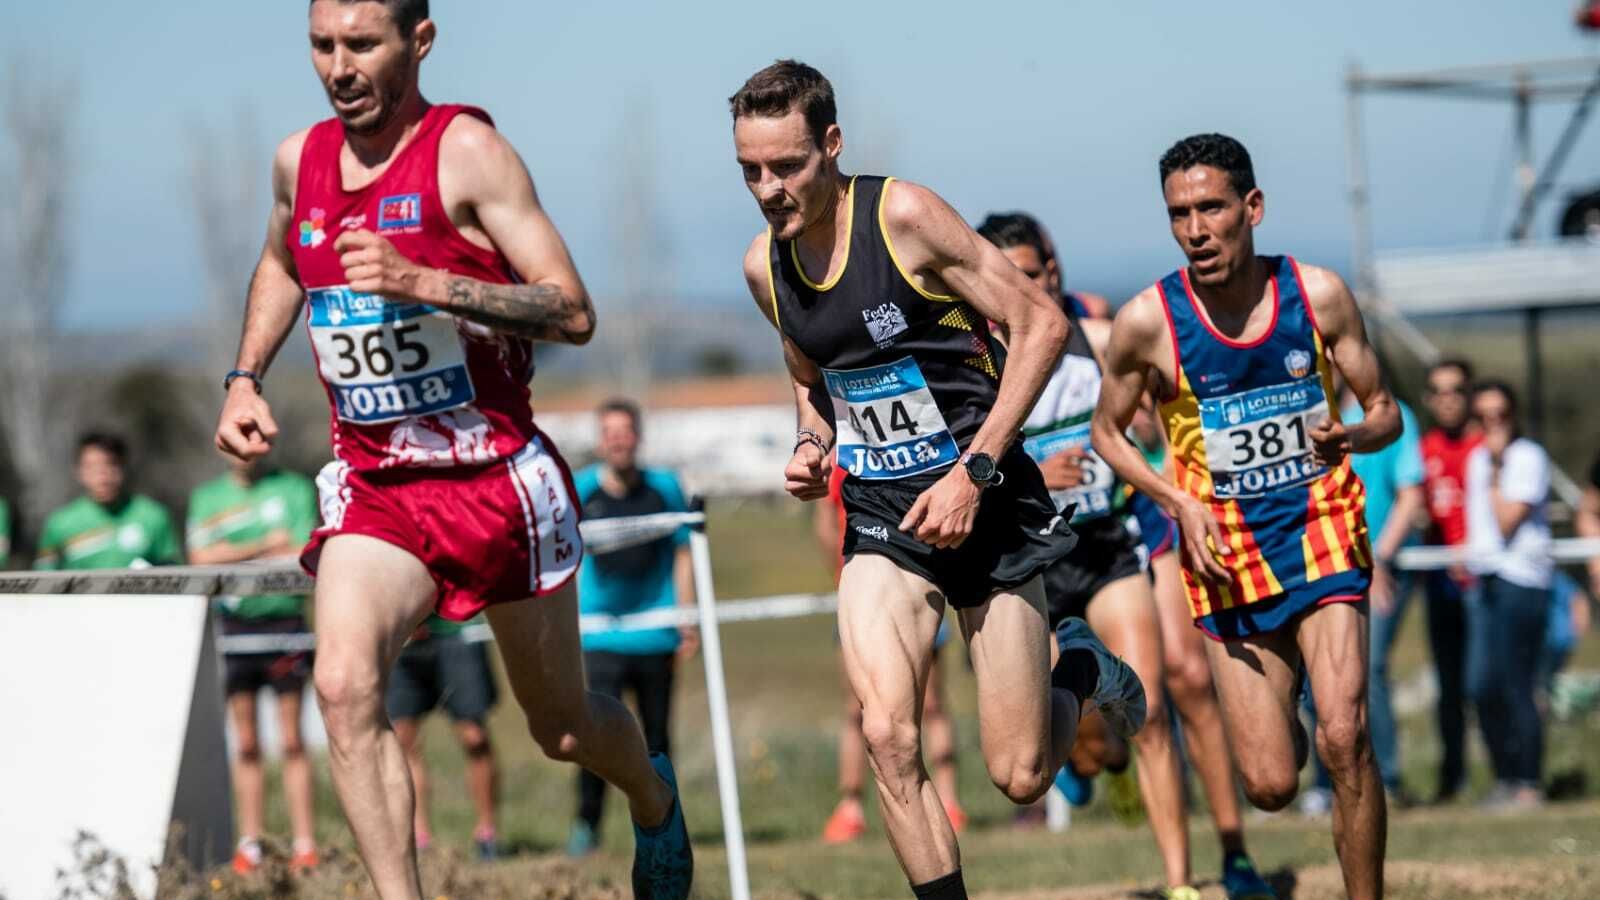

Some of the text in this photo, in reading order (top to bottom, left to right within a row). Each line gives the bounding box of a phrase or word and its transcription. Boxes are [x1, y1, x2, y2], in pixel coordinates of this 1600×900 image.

[331, 323, 429, 379] 365
[848, 400, 919, 445] 414
[1229, 414, 1306, 466] 381
[848, 441, 940, 477] Joma
